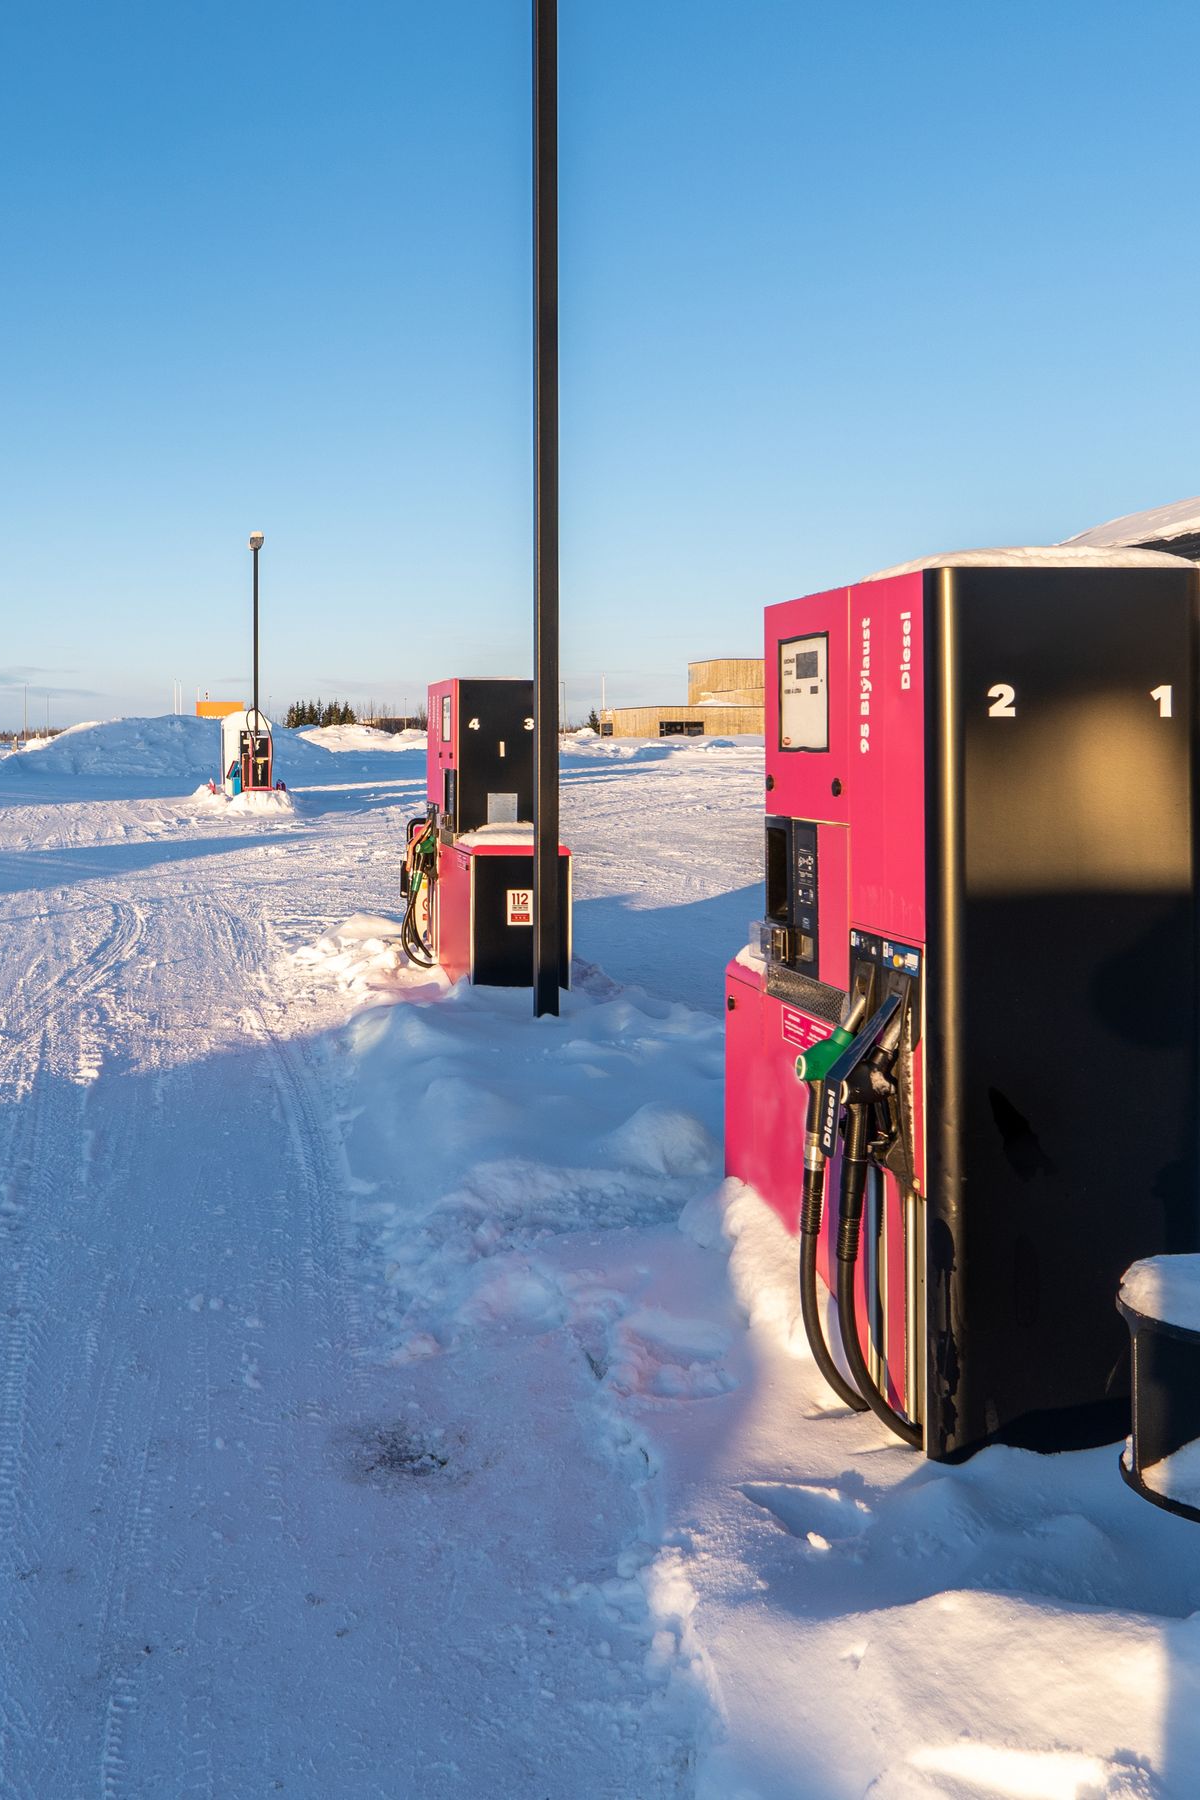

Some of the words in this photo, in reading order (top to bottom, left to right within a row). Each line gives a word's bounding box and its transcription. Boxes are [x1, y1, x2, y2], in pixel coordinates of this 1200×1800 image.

[860, 617, 872, 715] Blýlaust
[900, 611, 910, 689] Diesel
[987, 684, 1016, 717] 2
[1150, 685, 1172, 717] 1
[468, 718, 480, 730] 4
[523, 718, 534, 730] 3
[860, 724, 870, 753] 95
[512, 893, 528, 904] 112
[823, 1089, 835, 1147] Diesel
